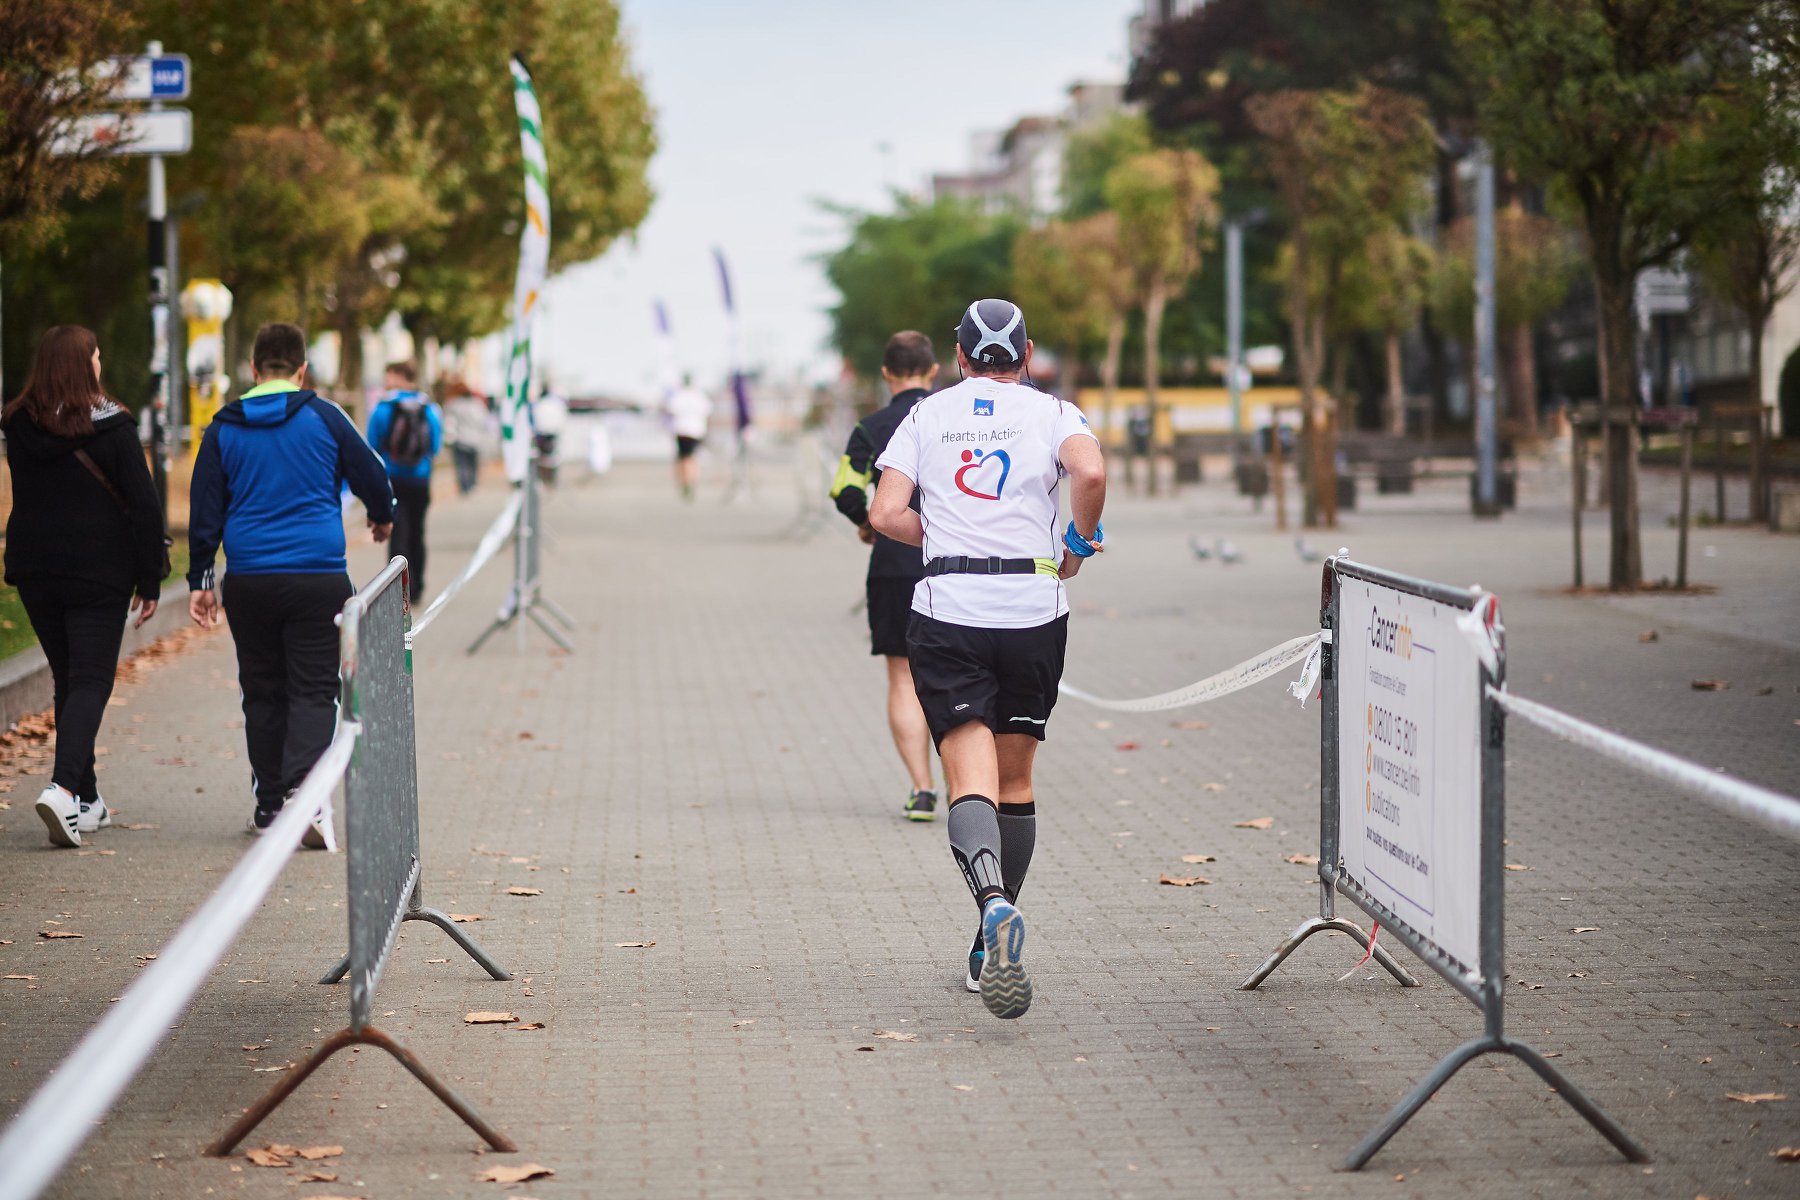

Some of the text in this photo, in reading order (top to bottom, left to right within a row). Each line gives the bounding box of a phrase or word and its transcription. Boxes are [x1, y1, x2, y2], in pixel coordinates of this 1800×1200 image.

[941, 430, 976, 443] Hearts
[978, 430, 988, 442] in
[1373, 704, 1418, 759] 0800 15 801
